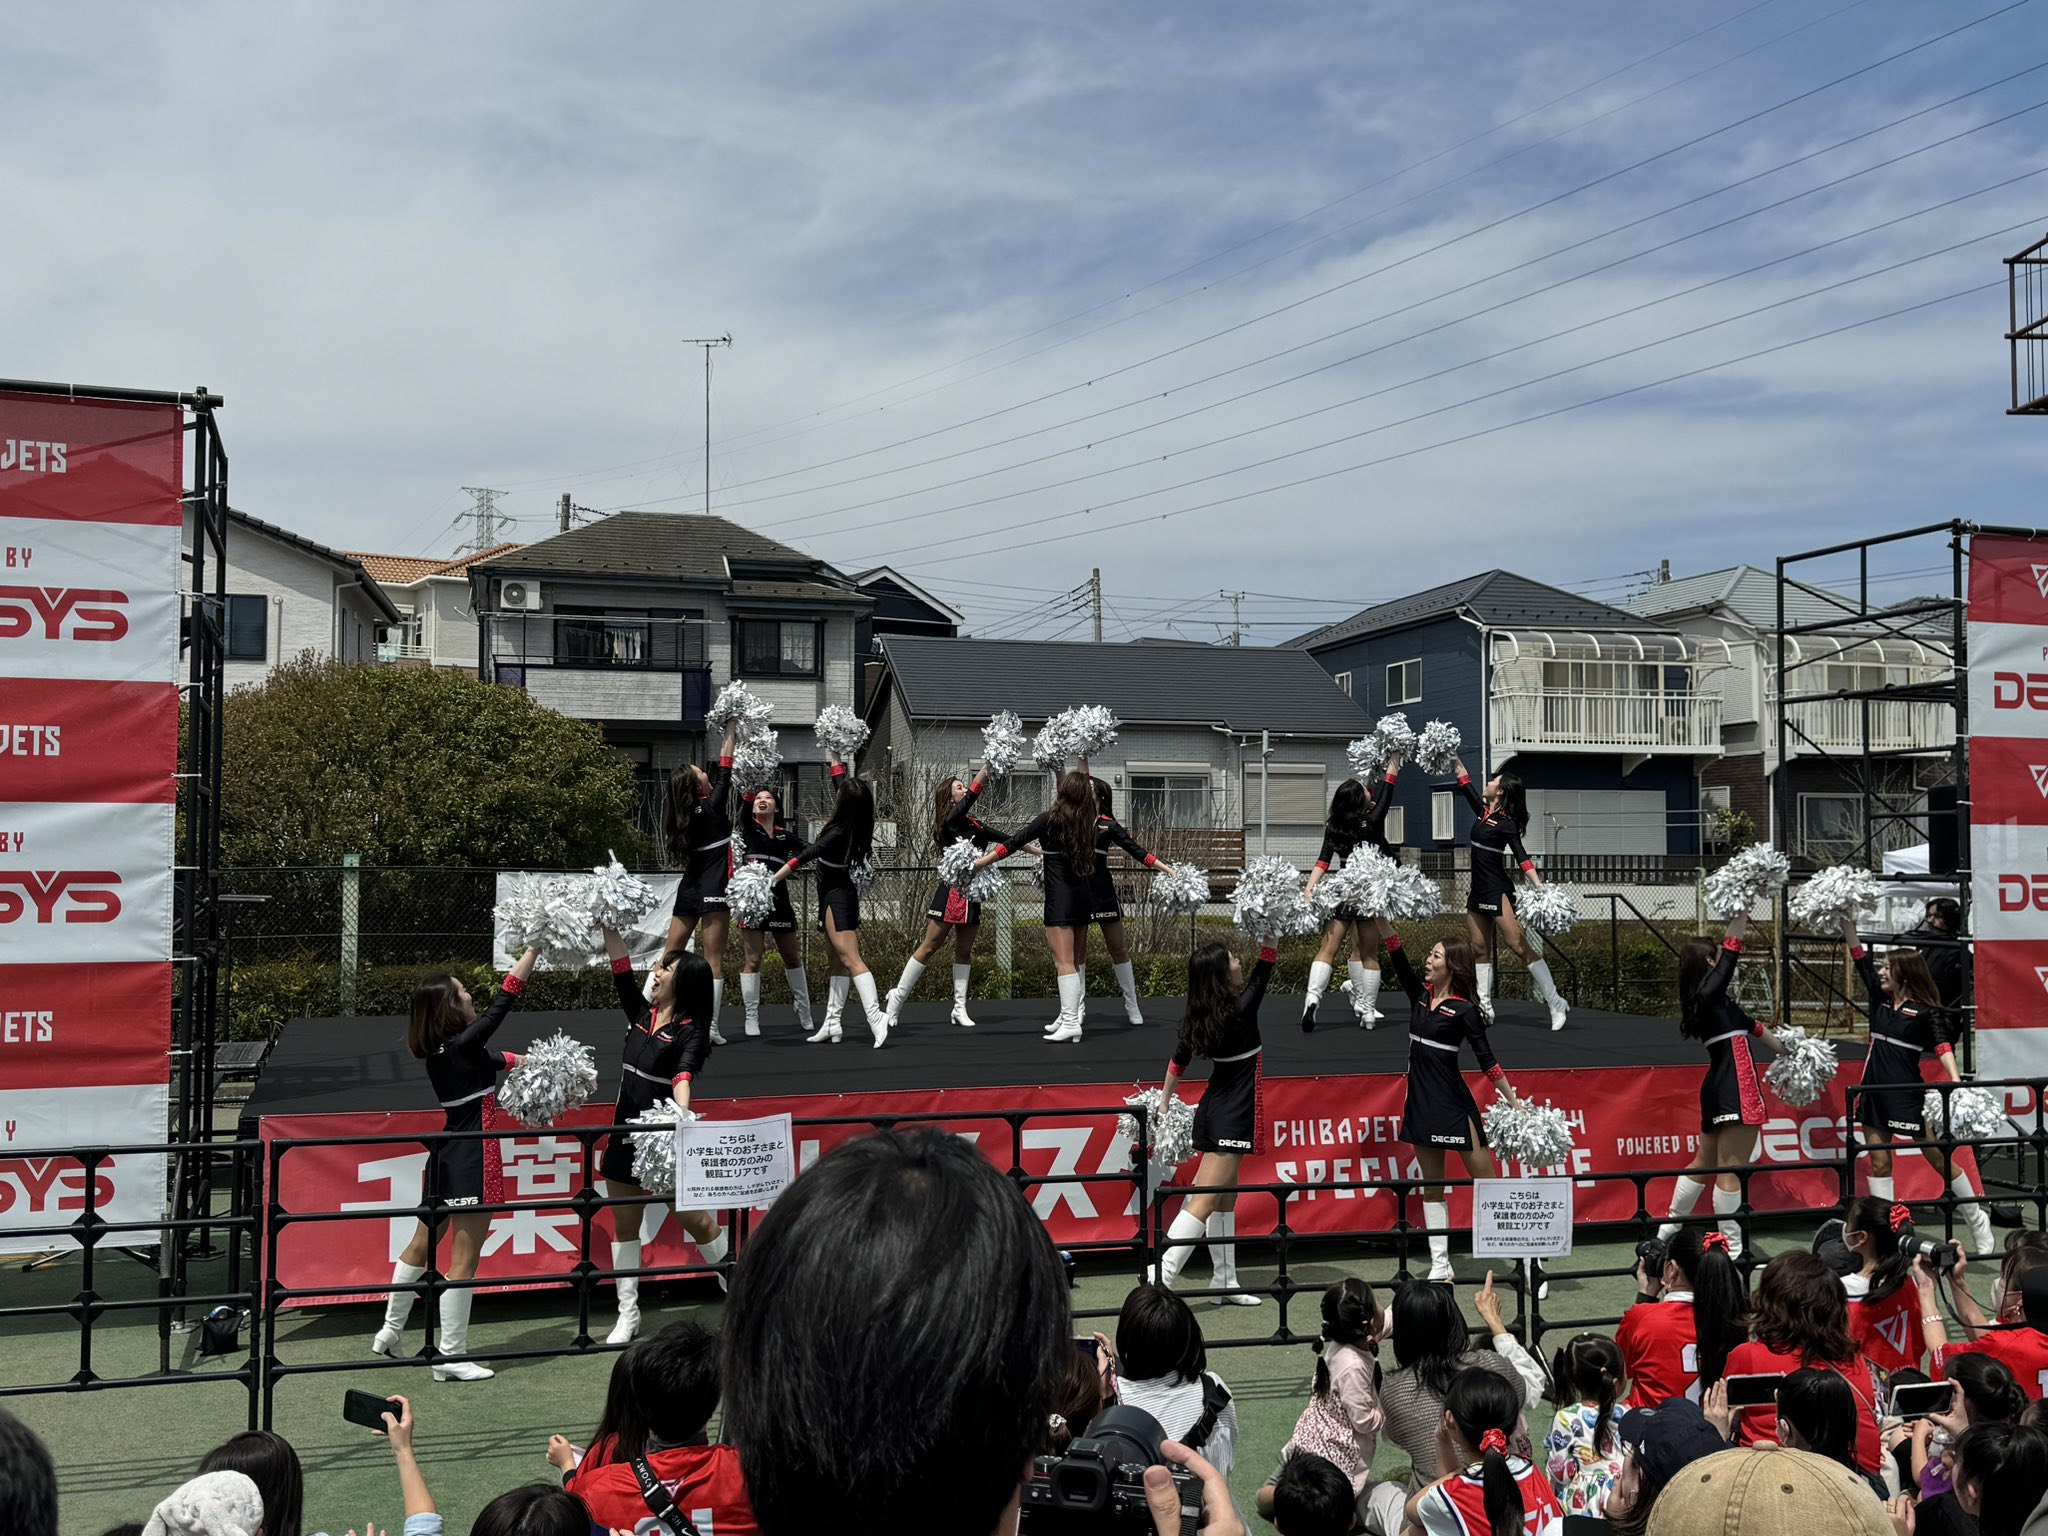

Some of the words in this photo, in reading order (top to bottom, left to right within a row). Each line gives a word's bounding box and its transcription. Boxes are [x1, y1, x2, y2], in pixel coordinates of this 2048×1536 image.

[1, 439, 67, 473] JETS
[6, 547, 32, 568] BY
[0, 1011, 53, 1043] ETS
[719, 1134, 756, 1145] こちらは
[1218, 1139, 1252, 1149] DECSYS
[1431, 1134, 1466, 1144] DECSYS
[686, 1141, 784, 1156] 小学生以下のお子さまと
[1617, 1136, 1680, 1156] POWERED
[700, 1154, 774, 1168] 保護者の方のみの
[705, 1165, 769, 1179] 観覧エリアです
[1509, 1191, 1540, 1200] こちらは
[1481, 1201, 1565, 1210] 小学生以下のお子さまと
[1493, 1212, 1555, 1220] 保護者の方のみの
[1497, 1222, 1551, 1231] 観覧エリアです
